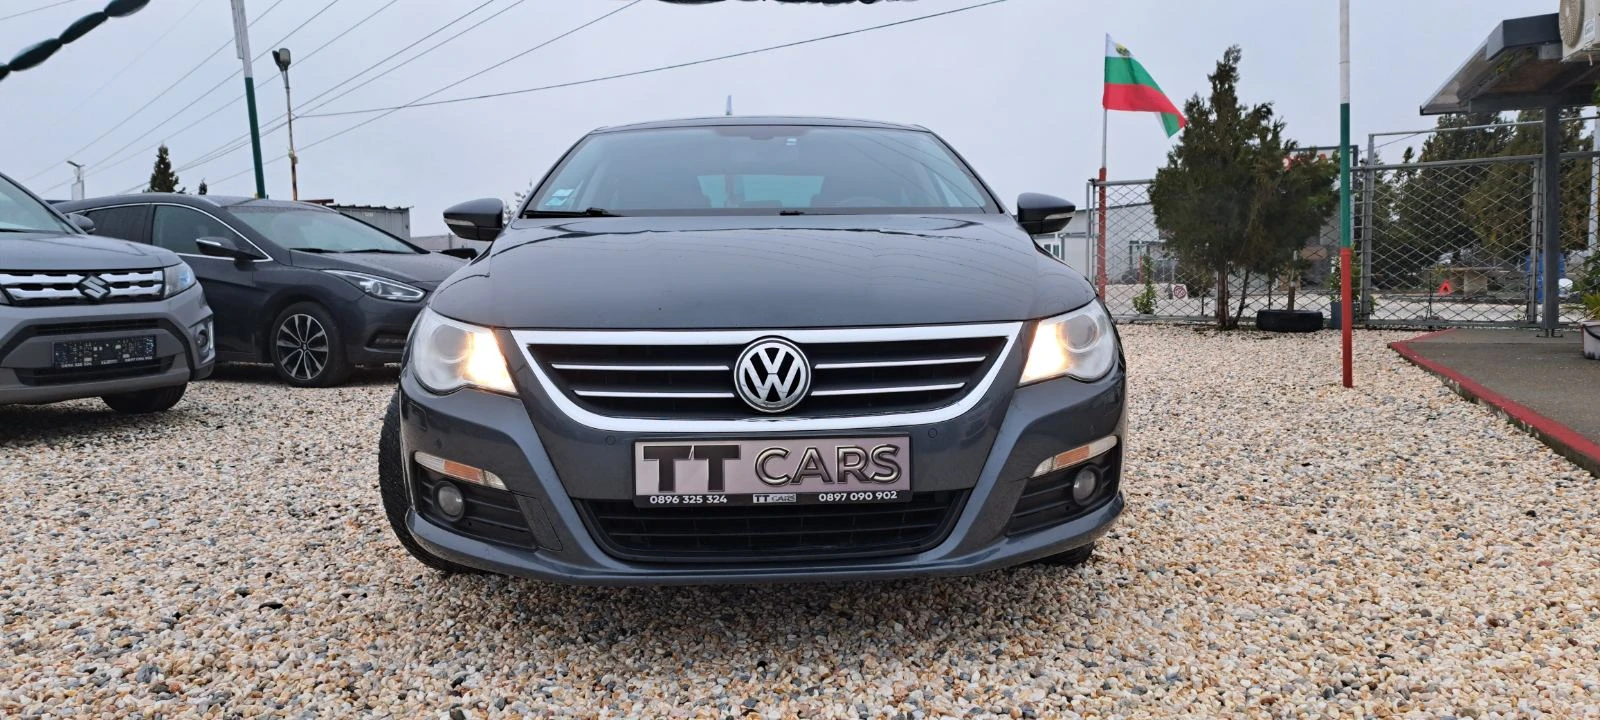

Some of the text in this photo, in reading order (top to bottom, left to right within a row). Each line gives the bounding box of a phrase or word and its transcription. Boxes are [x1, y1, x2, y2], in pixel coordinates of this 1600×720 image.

[735, 339, 810, 411] VW
[643, 443, 903, 492] TT CARS
[649, 495, 728, 504] 0896 325 324
[754, 494, 770, 502] TT
[818, 490, 898, 502] 0897 090 902
